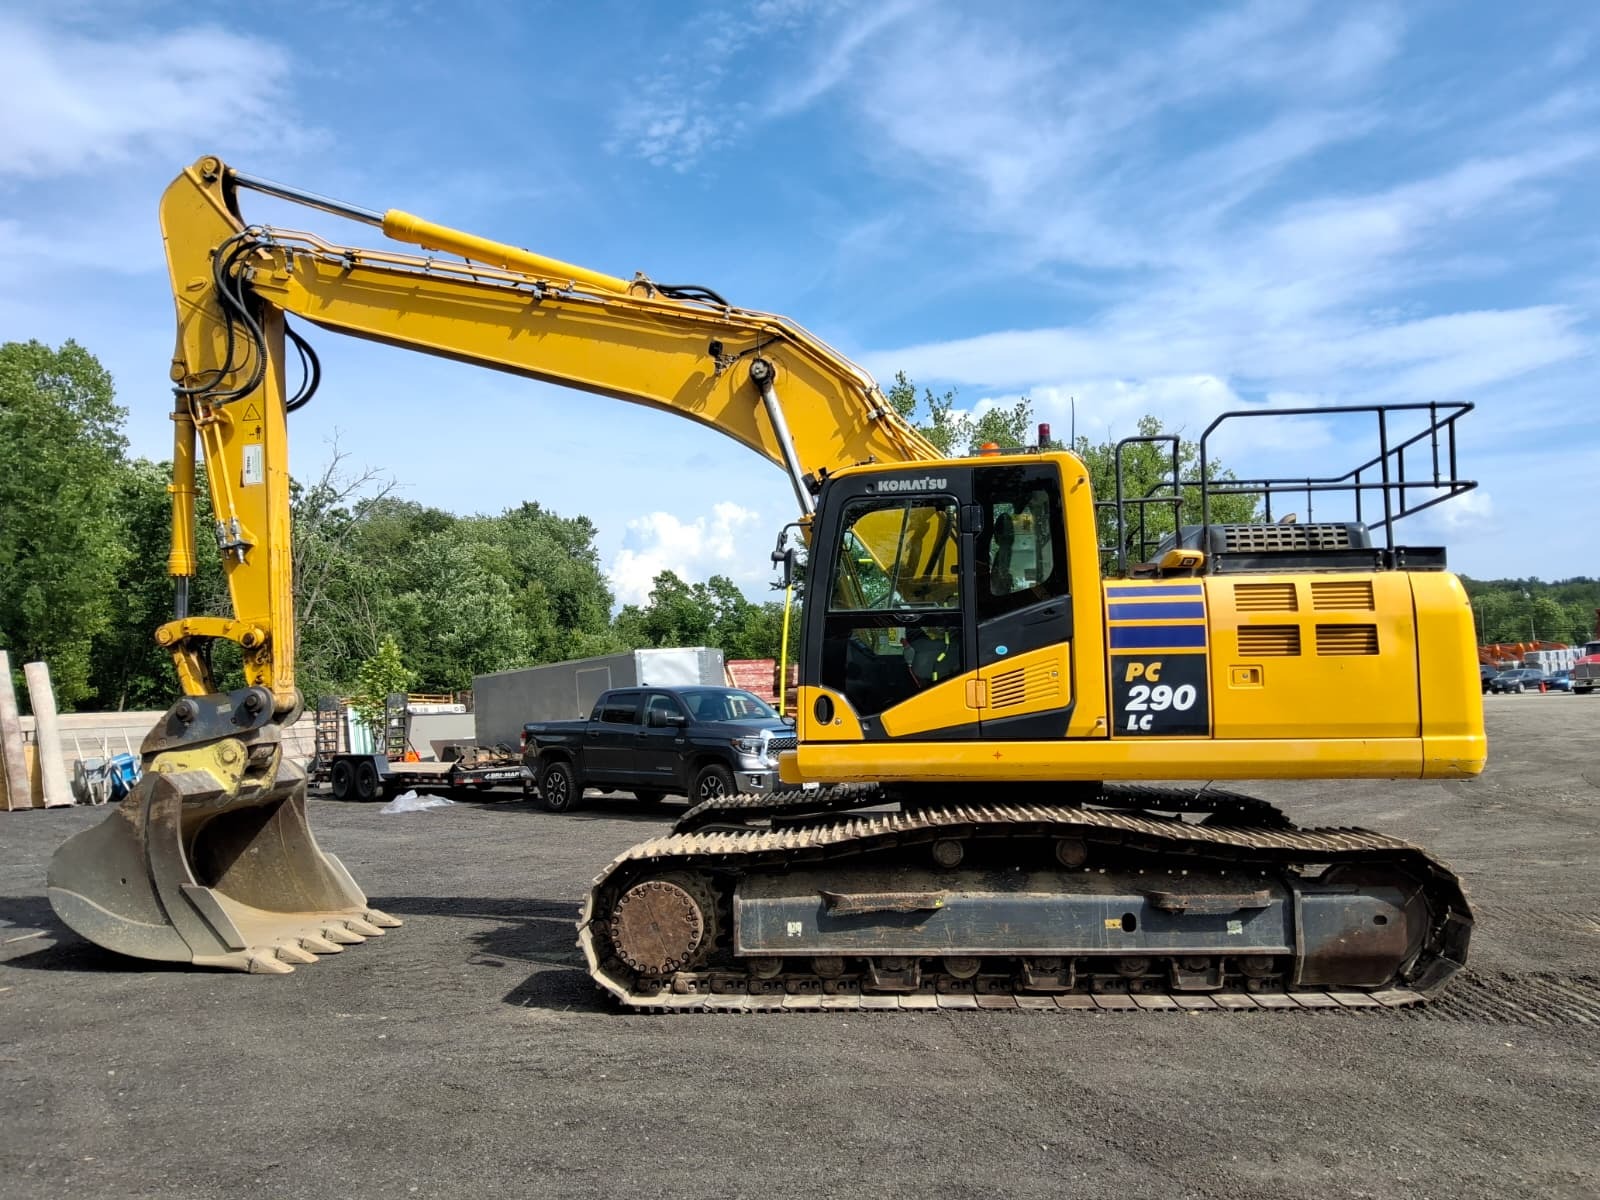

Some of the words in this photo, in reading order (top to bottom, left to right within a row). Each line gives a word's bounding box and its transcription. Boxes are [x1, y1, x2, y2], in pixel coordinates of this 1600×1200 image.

[878, 477, 947, 491] KOMATSU
[1125, 662, 1162, 682] PC
[1125, 684, 1196, 711] 290
[1126, 714, 1154, 731] LC
